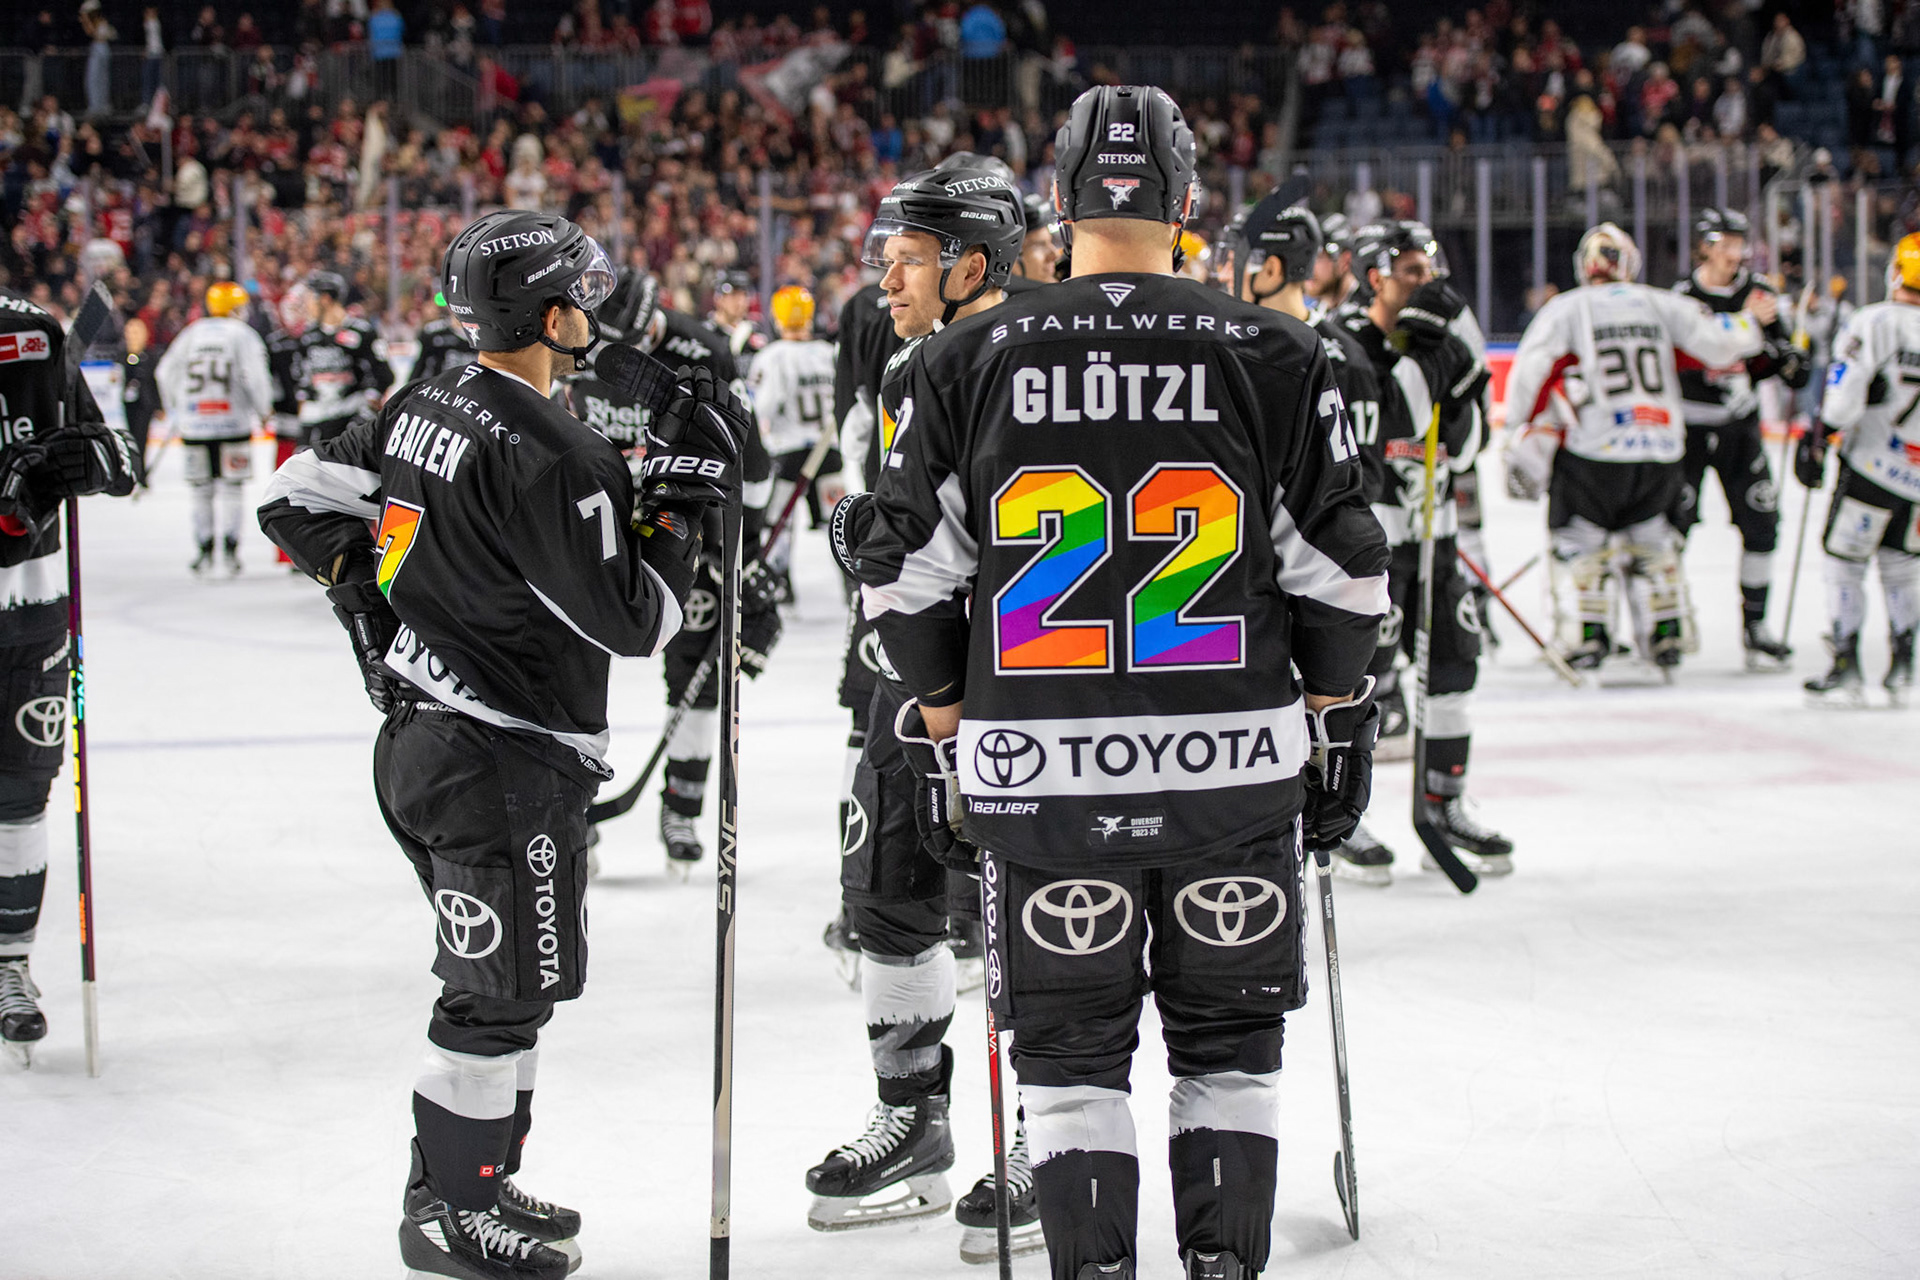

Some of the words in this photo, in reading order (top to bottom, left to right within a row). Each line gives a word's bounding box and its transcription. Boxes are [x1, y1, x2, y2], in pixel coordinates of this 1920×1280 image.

[1108, 122, 1135, 142] 22
[1097, 153, 1147, 165] STETSON
[944, 176, 1006, 198] STETSON
[960, 210, 997, 222] BAUER
[480, 229, 557, 257] STETSON
[451, 275, 458, 294] 7
[527, 258, 562, 284] BAUER
[186, 358, 232, 396] 54
[1012, 351, 1220, 425] GLÖTZL
[1597, 345, 1666, 396] 30
[1351, 400, 1380, 446] 17
[384, 411, 471, 483] BAILEN
[575, 489, 618, 562] 7
[375, 496, 426, 607] 7
[990, 461, 1246, 677] 22
[1058, 726, 1281, 778] TOYOTA
[1332, 754, 1344, 792] BAUER
[932, 786, 940, 824] BAUER
[972, 801, 1041, 816] BAUER
[1130, 816, 1163, 826] DIVERSITY
[1131, 828, 1159, 838] 2023-24
[718, 798, 738, 916] SYNC
[535, 878, 561, 991] TOYOTA
